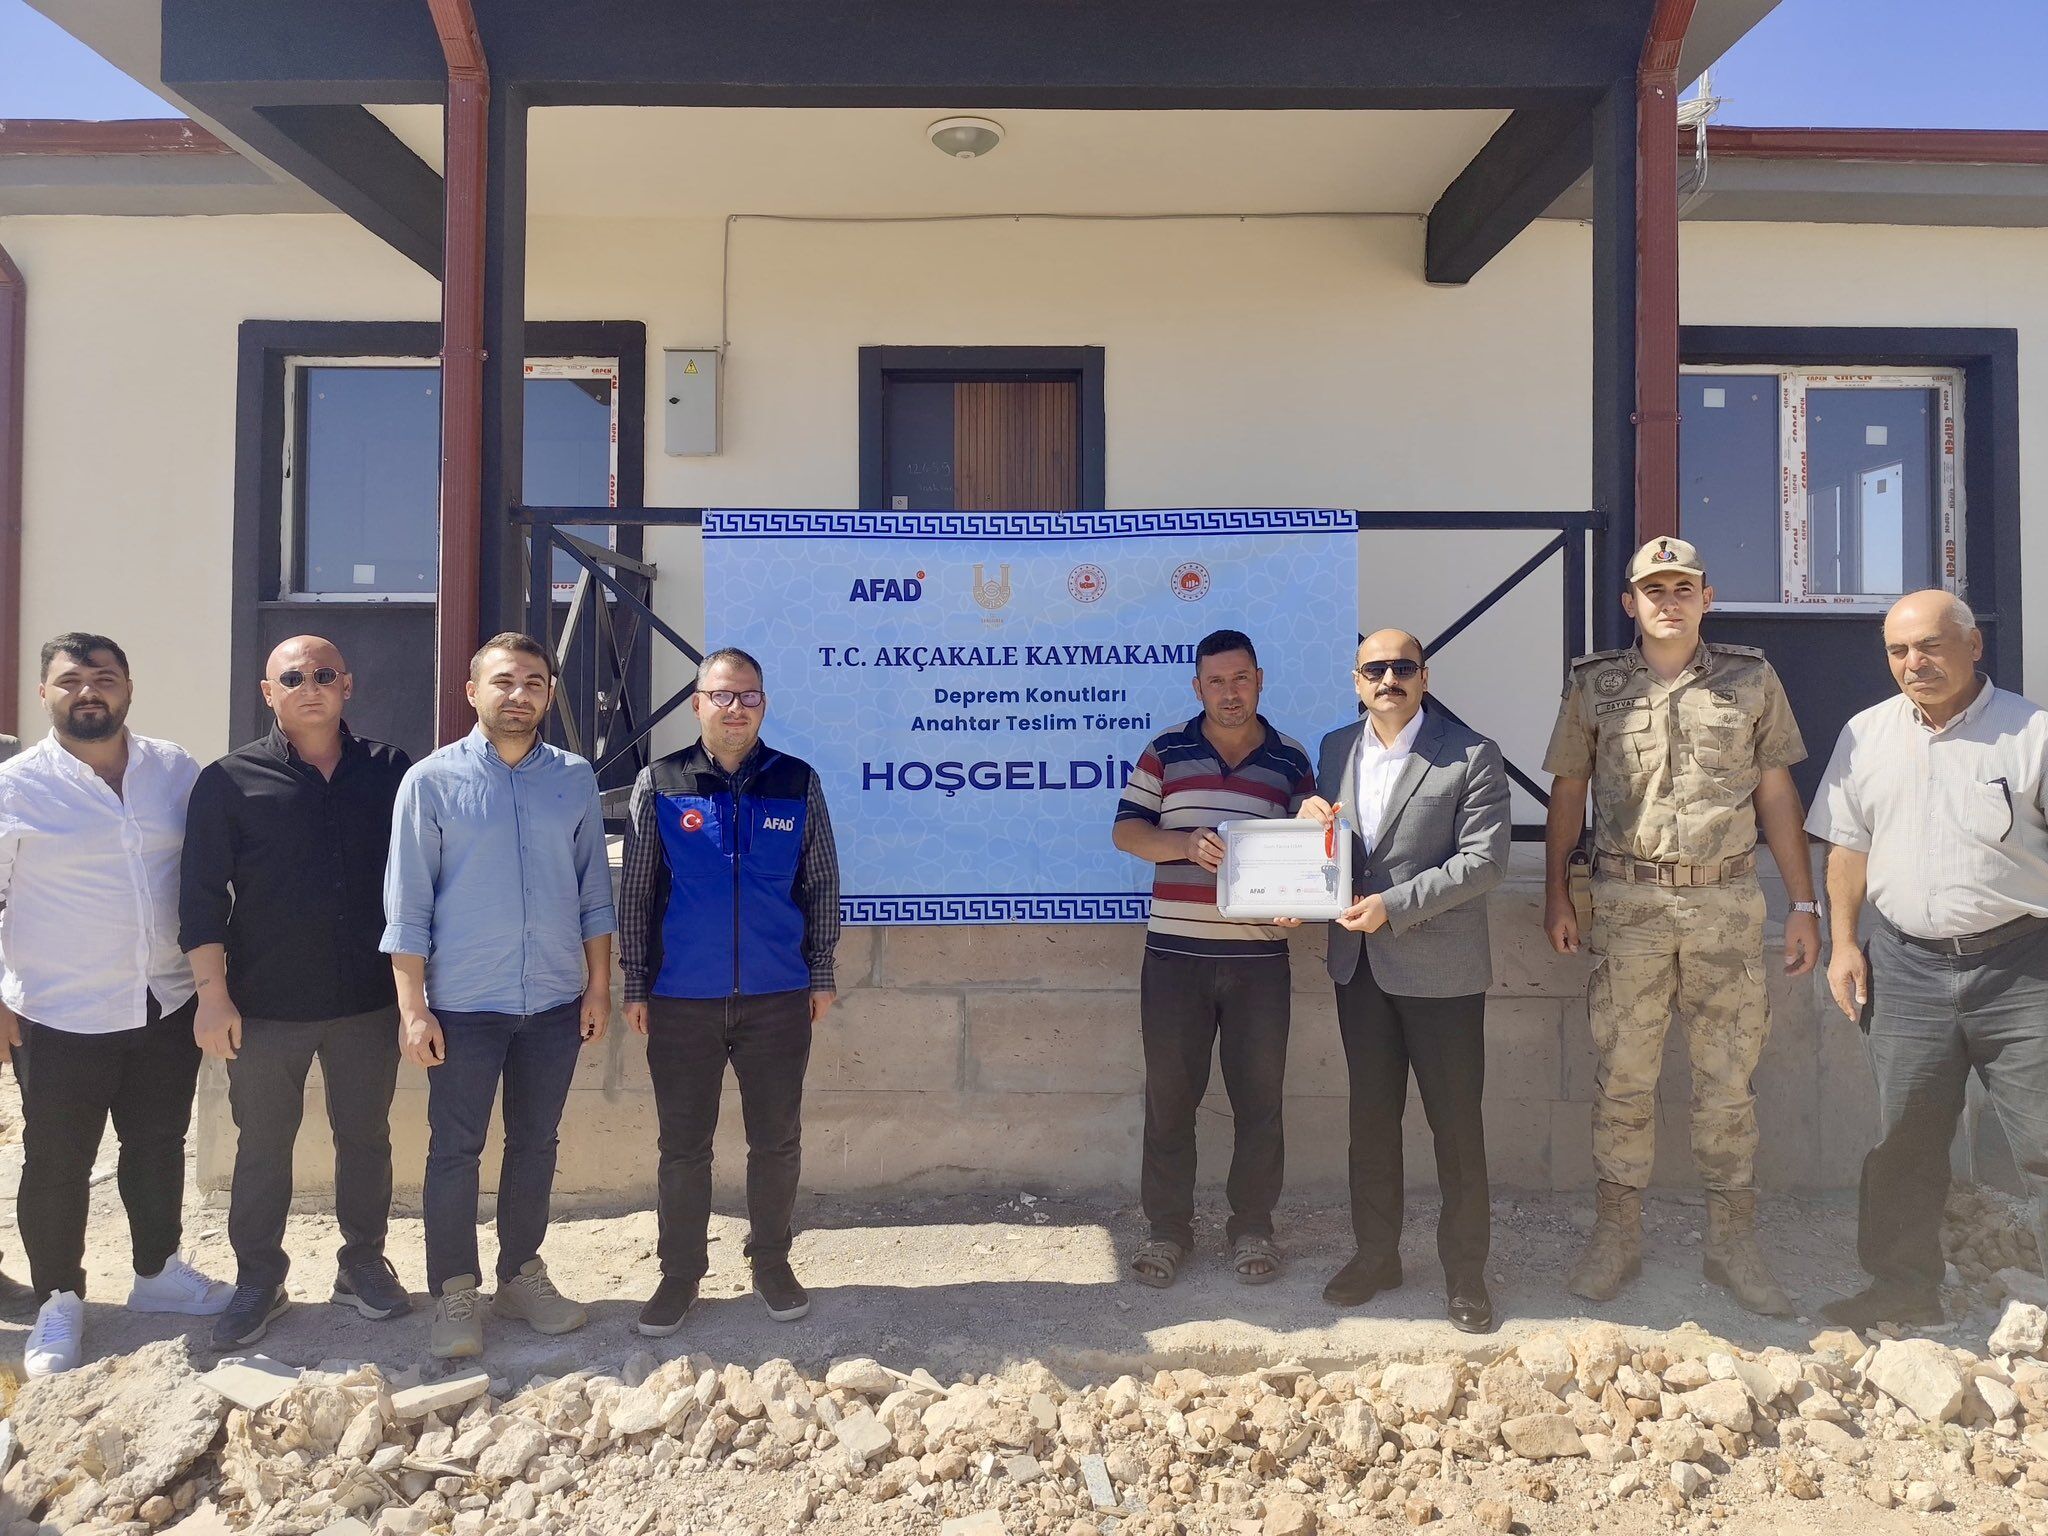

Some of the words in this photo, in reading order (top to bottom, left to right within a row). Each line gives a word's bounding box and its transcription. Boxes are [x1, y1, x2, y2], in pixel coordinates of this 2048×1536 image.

[848, 578, 922, 602] AFAD
[818, 647, 867, 667] T.C.
[873, 646, 1018, 672] AKÇAKALE
[934, 688, 1020, 708] Deprem
[1026, 686, 1126, 703] Konutları
[911, 715, 1000, 731] Anahtar
[1005, 713, 1077, 731] Teslim
[1082, 712, 1151, 730] Töreni
[763, 817, 794, 832] AFAD
